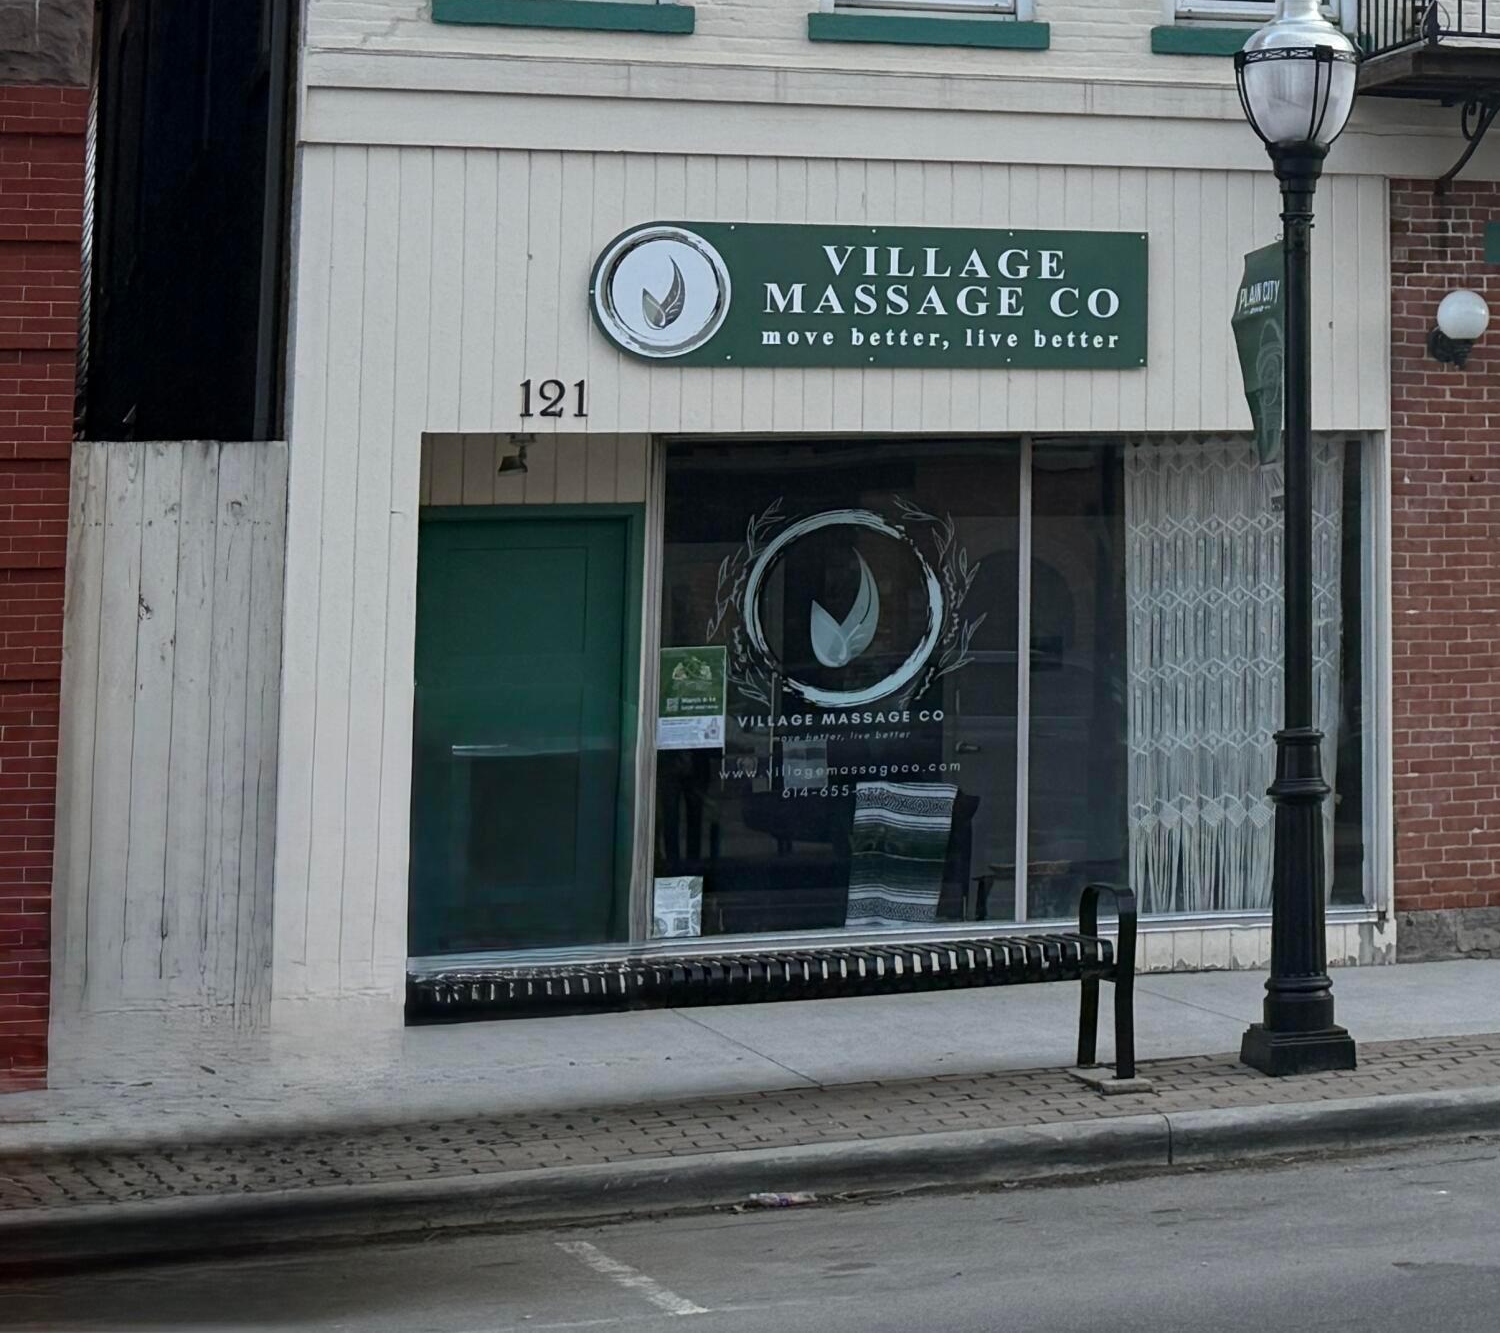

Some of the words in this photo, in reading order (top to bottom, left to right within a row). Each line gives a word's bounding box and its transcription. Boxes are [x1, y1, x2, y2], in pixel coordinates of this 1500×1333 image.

[822, 245, 1066, 280] VILLAGE
[763, 282, 1025, 317] MASSAGE
[1050, 288, 1120, 318] CO
[762, 331, 834, 346] move
[852, 328, 949, 350] better,
[966, 328, 1018, 347] live
[1035, 329, 1119, 348] better
[519, 378, 589, 419] 121
[737, 714, 813, 728] VILLAGE
[822, 711, 911, 725] MASSAGE
[919, 710, 945, 722] CO
[719, 762, 961, 780] www.villagemassageco.com
